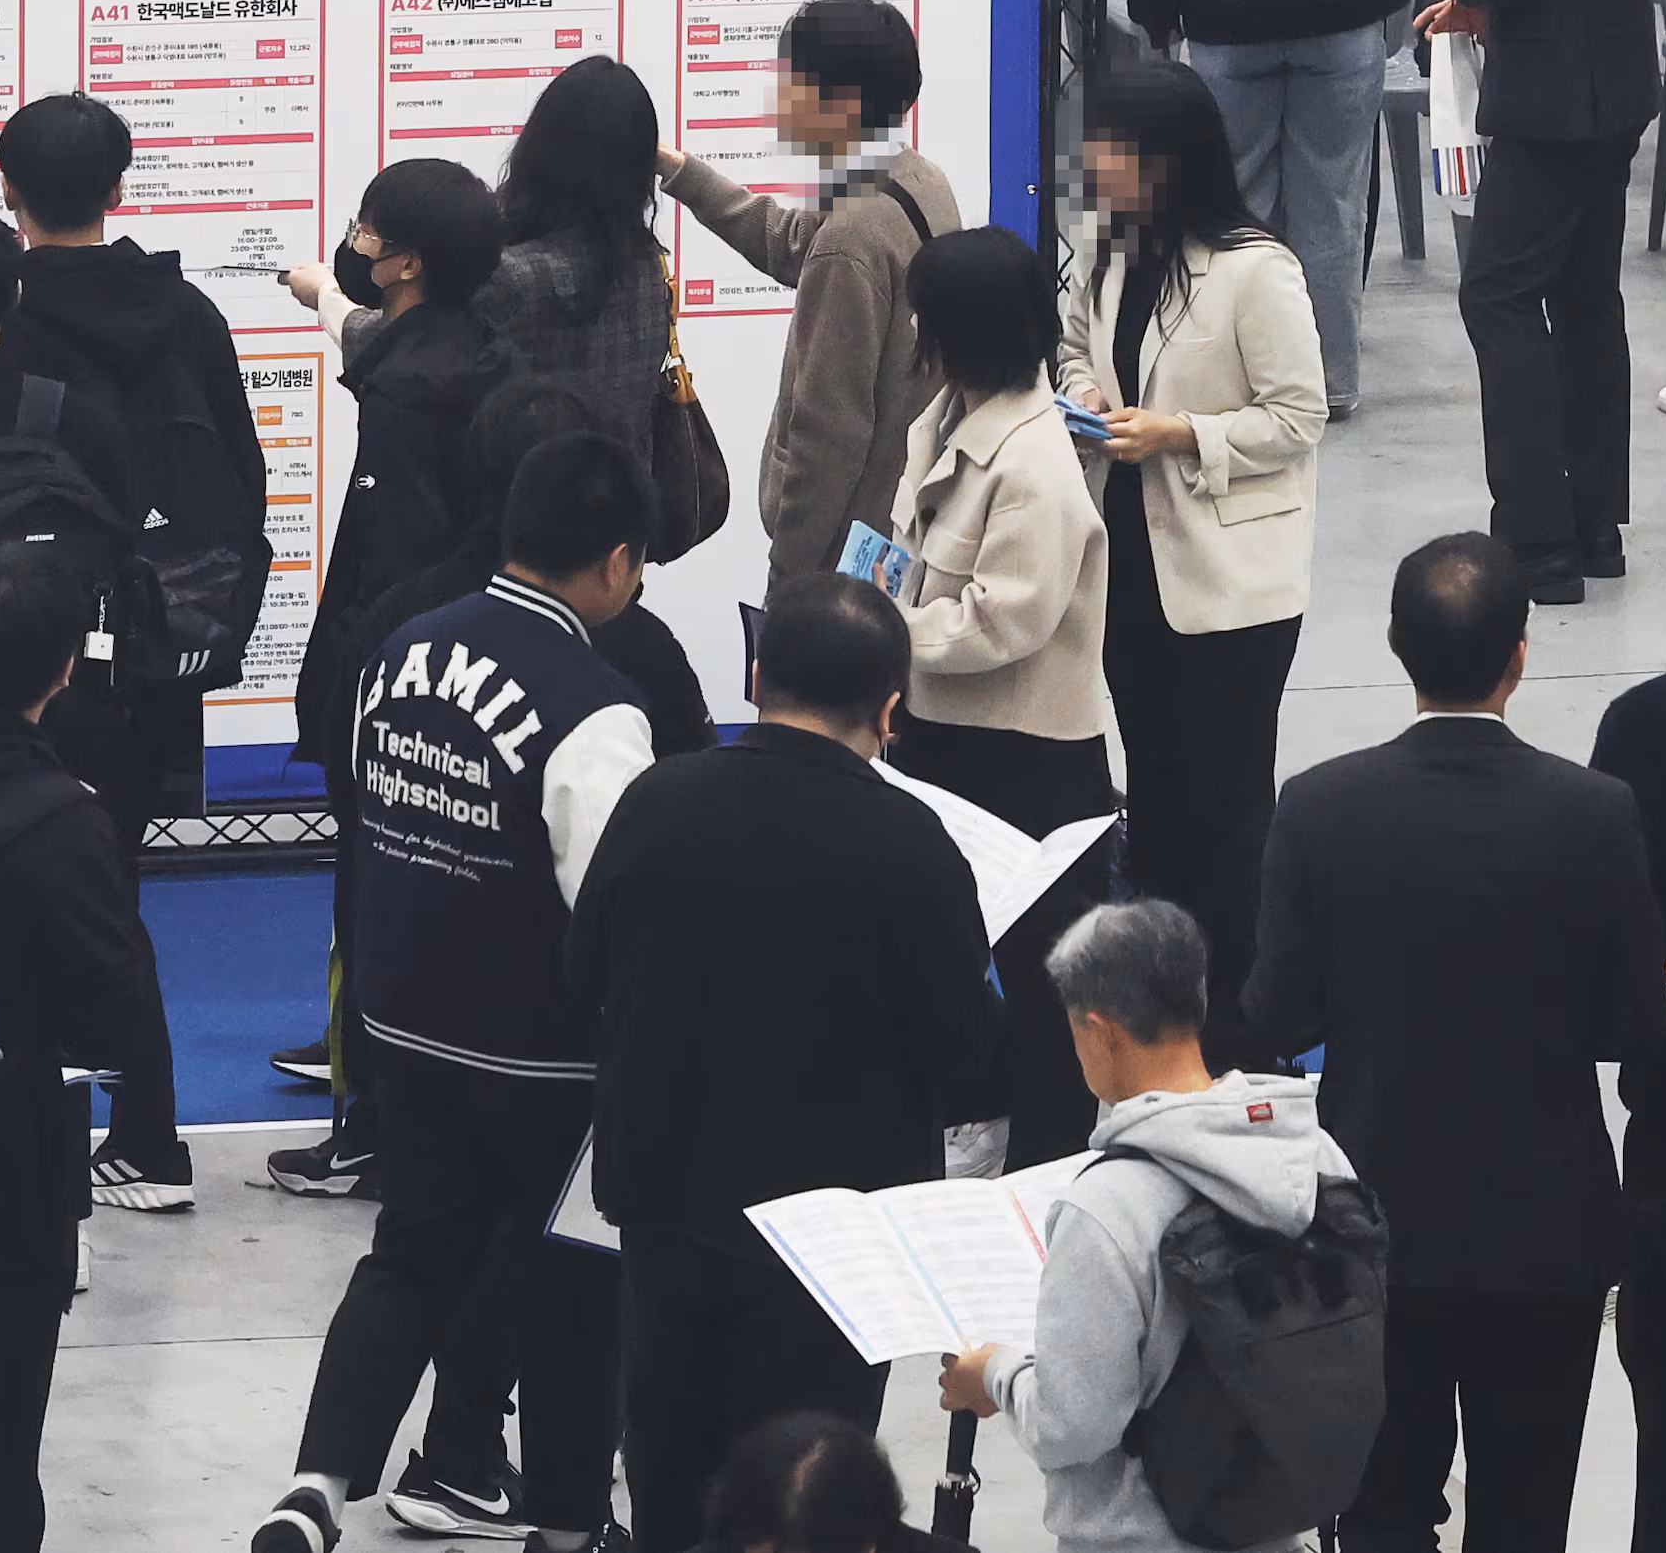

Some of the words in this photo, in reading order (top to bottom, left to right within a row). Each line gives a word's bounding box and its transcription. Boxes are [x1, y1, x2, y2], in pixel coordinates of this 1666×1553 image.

[91, 5, 129, 21] A41
[137, 0, 232, 20] 한국맥도날드
[250, 369, 313, 389] 윌스기념병원
[143, 518, 169, 529] adidas
[372, 719, 492, 789] Technical
[365, 759, 501, 831] Highschool
